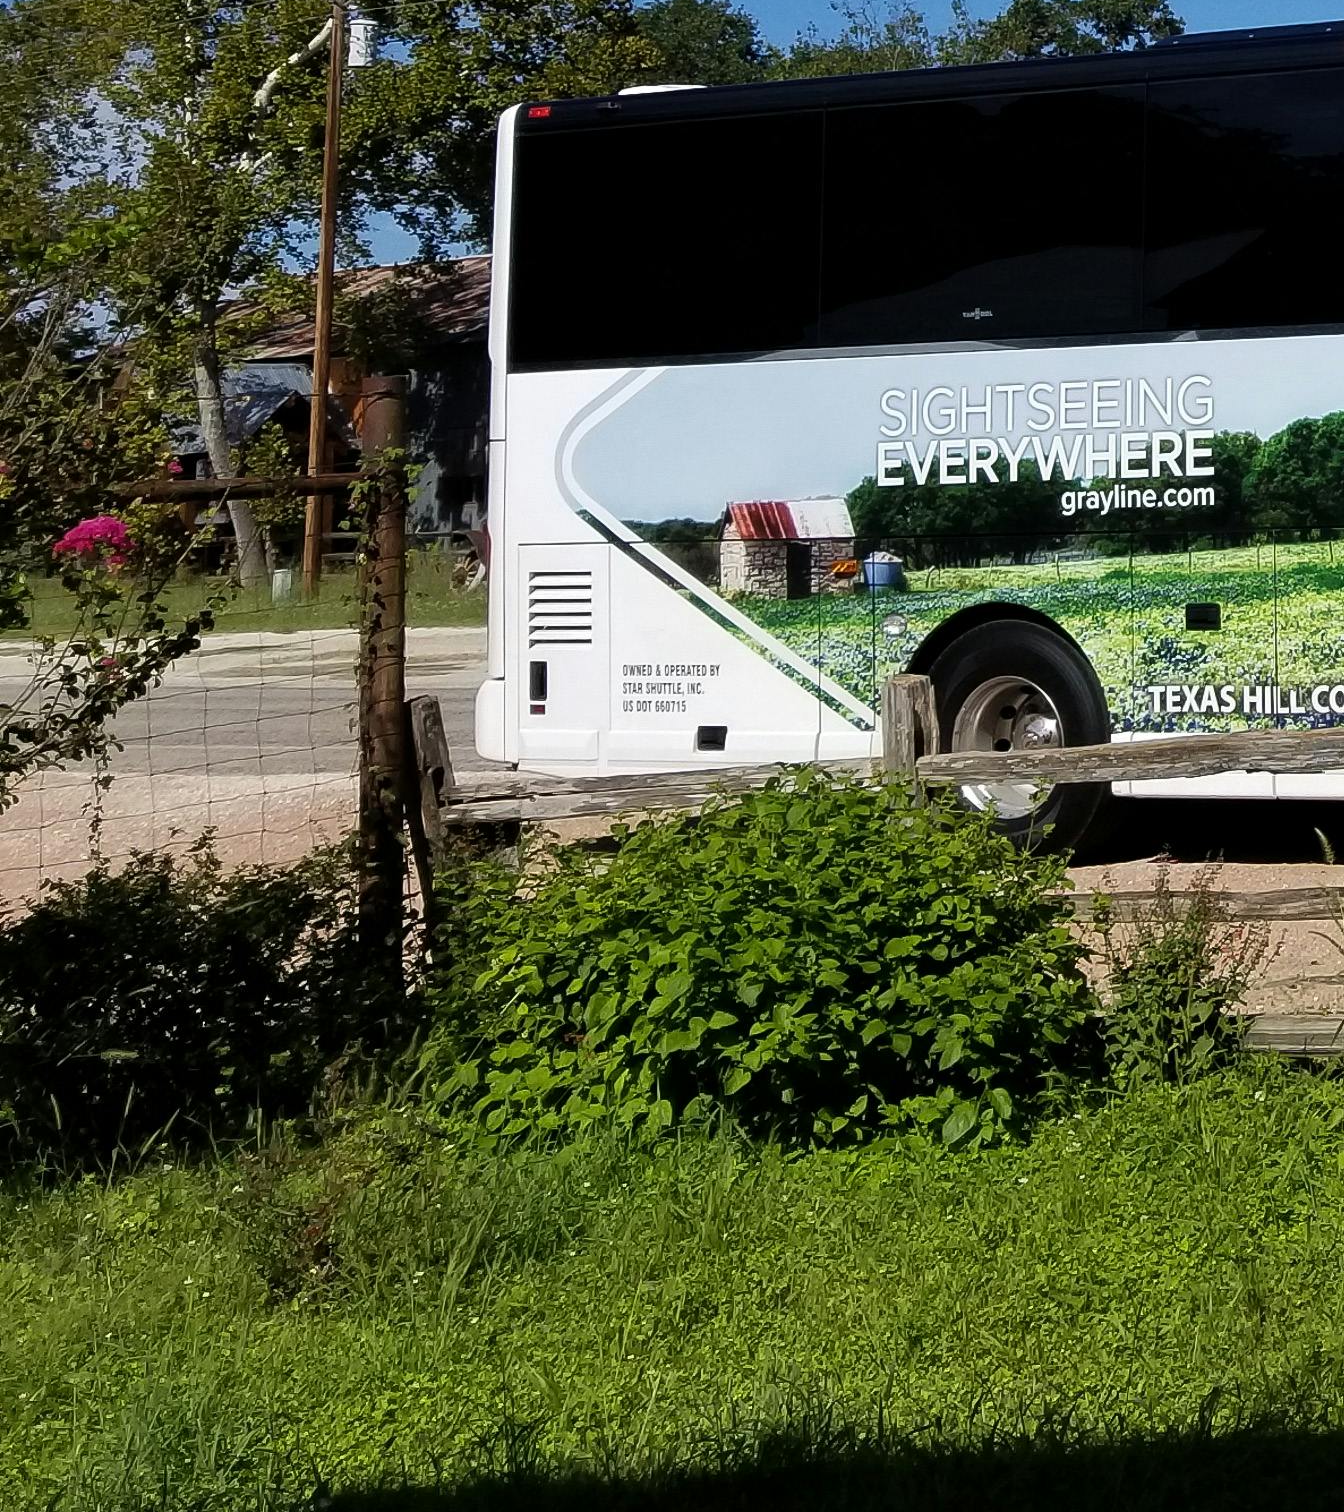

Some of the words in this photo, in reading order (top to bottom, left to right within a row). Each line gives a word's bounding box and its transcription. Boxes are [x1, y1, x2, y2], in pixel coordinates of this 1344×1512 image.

[879, 375, 1215, 437] SIGHTSEEING
[877, 429, 1215, 487] EVERYWHERE
[1060, 487, 1215, 517] grayline.com
[623, 664, 652, 676] OWNED
[656, 664, 660, 676] &
[665, 664, 707, 676] OPERATED
[710, 664, 720, 676] BY
[623, 682, 643, 694] STAR
[646, 683, 684, 696] SHUTTLE,
[687, 683, 704, 694] INC.
[1150, 686, 1236, 714] TEXAS
[1243, 686, 1306, 714] HILL
[623, 701, 633, 712] US
[637, 701, 652, 712] DOT
[655, 701, 686, 712] 660715
